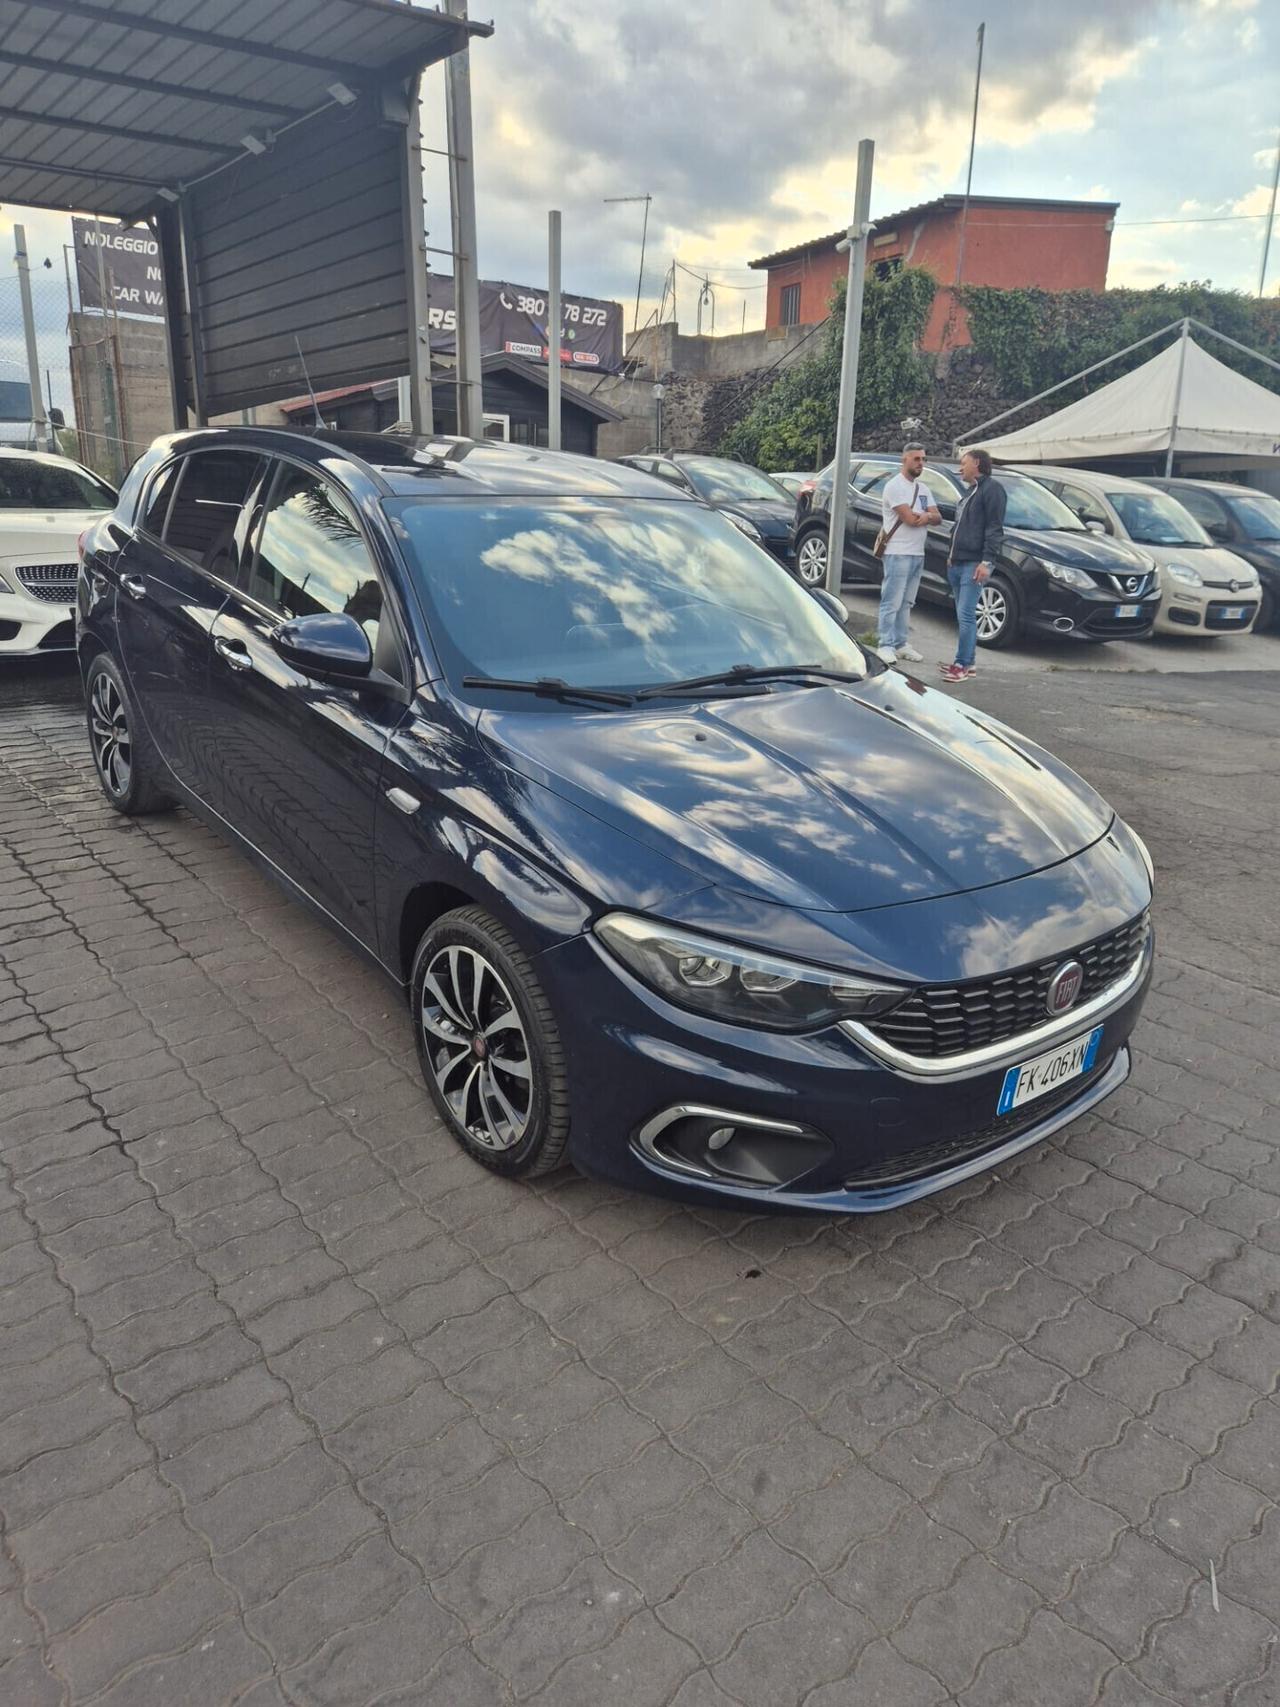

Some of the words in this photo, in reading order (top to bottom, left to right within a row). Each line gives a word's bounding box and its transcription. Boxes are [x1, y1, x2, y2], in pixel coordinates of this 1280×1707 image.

[84, 231, 159, 256] NOLEGGIO
[110, 286, 140, 303] CAR
[516, 295, 545, 316] 380
[582, 307, 608, 326] 272
[1056, 976, 1079, 1005] FIAT
